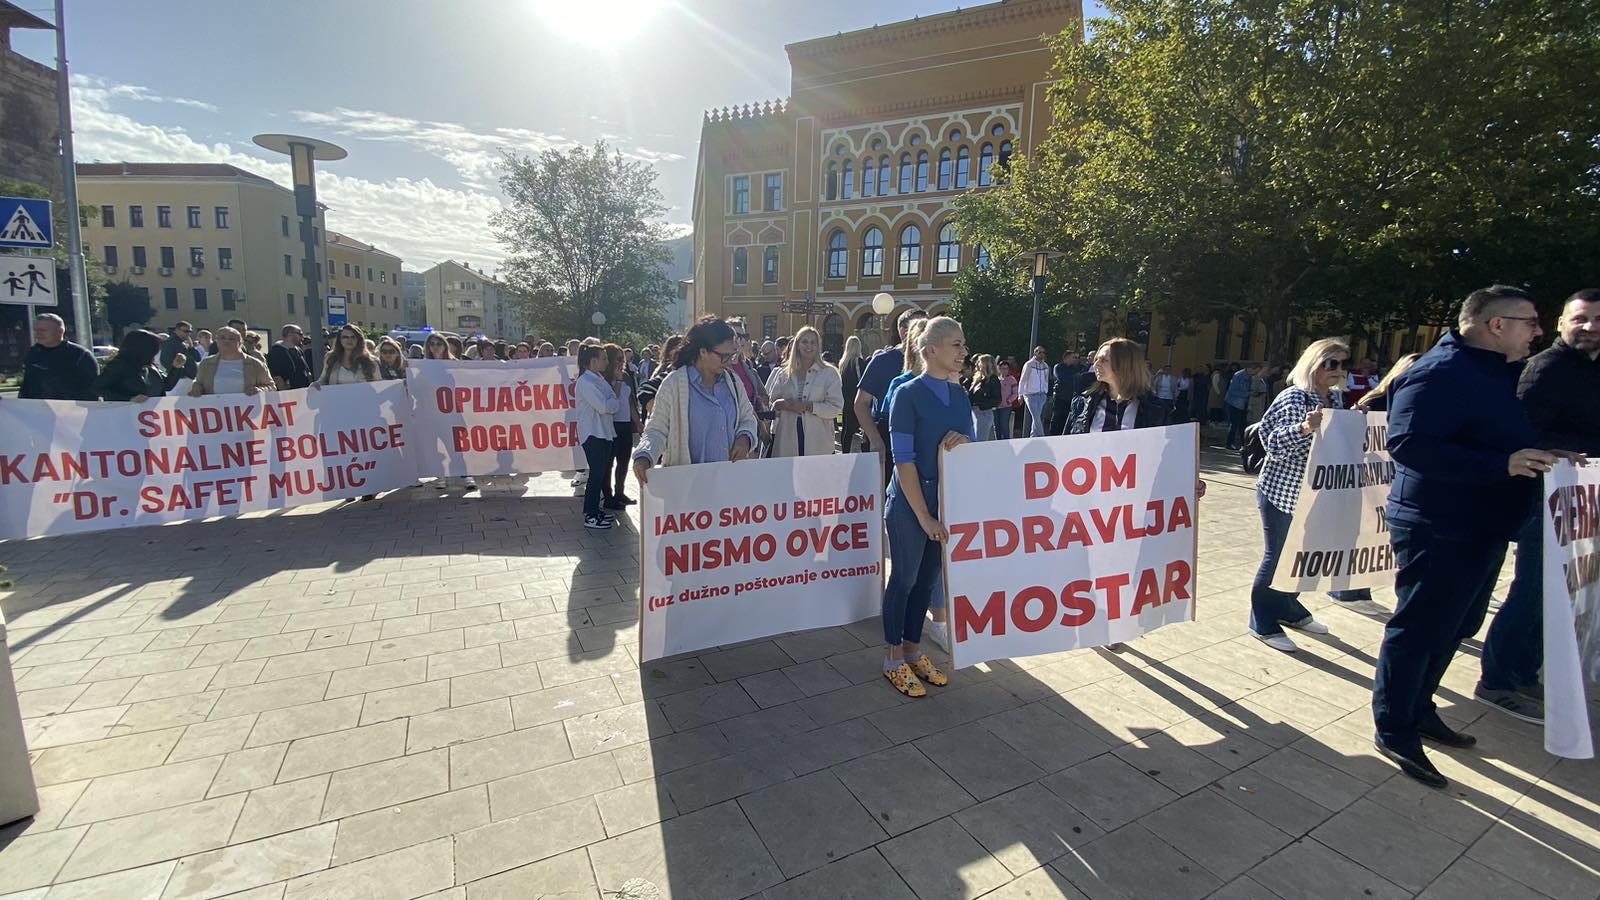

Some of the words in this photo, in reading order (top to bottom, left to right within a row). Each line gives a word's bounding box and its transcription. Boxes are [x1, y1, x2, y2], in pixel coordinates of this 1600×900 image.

[138, 401, 297, 438] SINDIKAT
[452, 424, 526, 453] BOGA
[0, 439, 267, 485] KANTONALNE
[276, 424, 405, 463] BOLNICE
[1024, 453, 1137, 500] DOM
[141, 475, 257, 514] SAFET
[1311, 464, 1355, 490] DOMA
[655, 511, 713, 536] IAKO
[718, 505, 768, 528] SMO
[773, 502, 787, 521] U
[793, 494, 875, 519] BIJELOM
[949, 496, 1192, 562] ZDRAVLJA
[664, 533, 777, 576] NISMO
[786, 522, 869, 557] OVCE
[1290, 551, 1344, 578] NOVI
[1346, 544, 1398, 576] KOLEK
[648, 595, 675, 612] (uz
[678, 586, 730, 603] dužno
[734, 568, 817, 596] poštovanje
[822, 561, 881, 580] ovcama)
[953, 560, 1192, 643] MOSTAR
